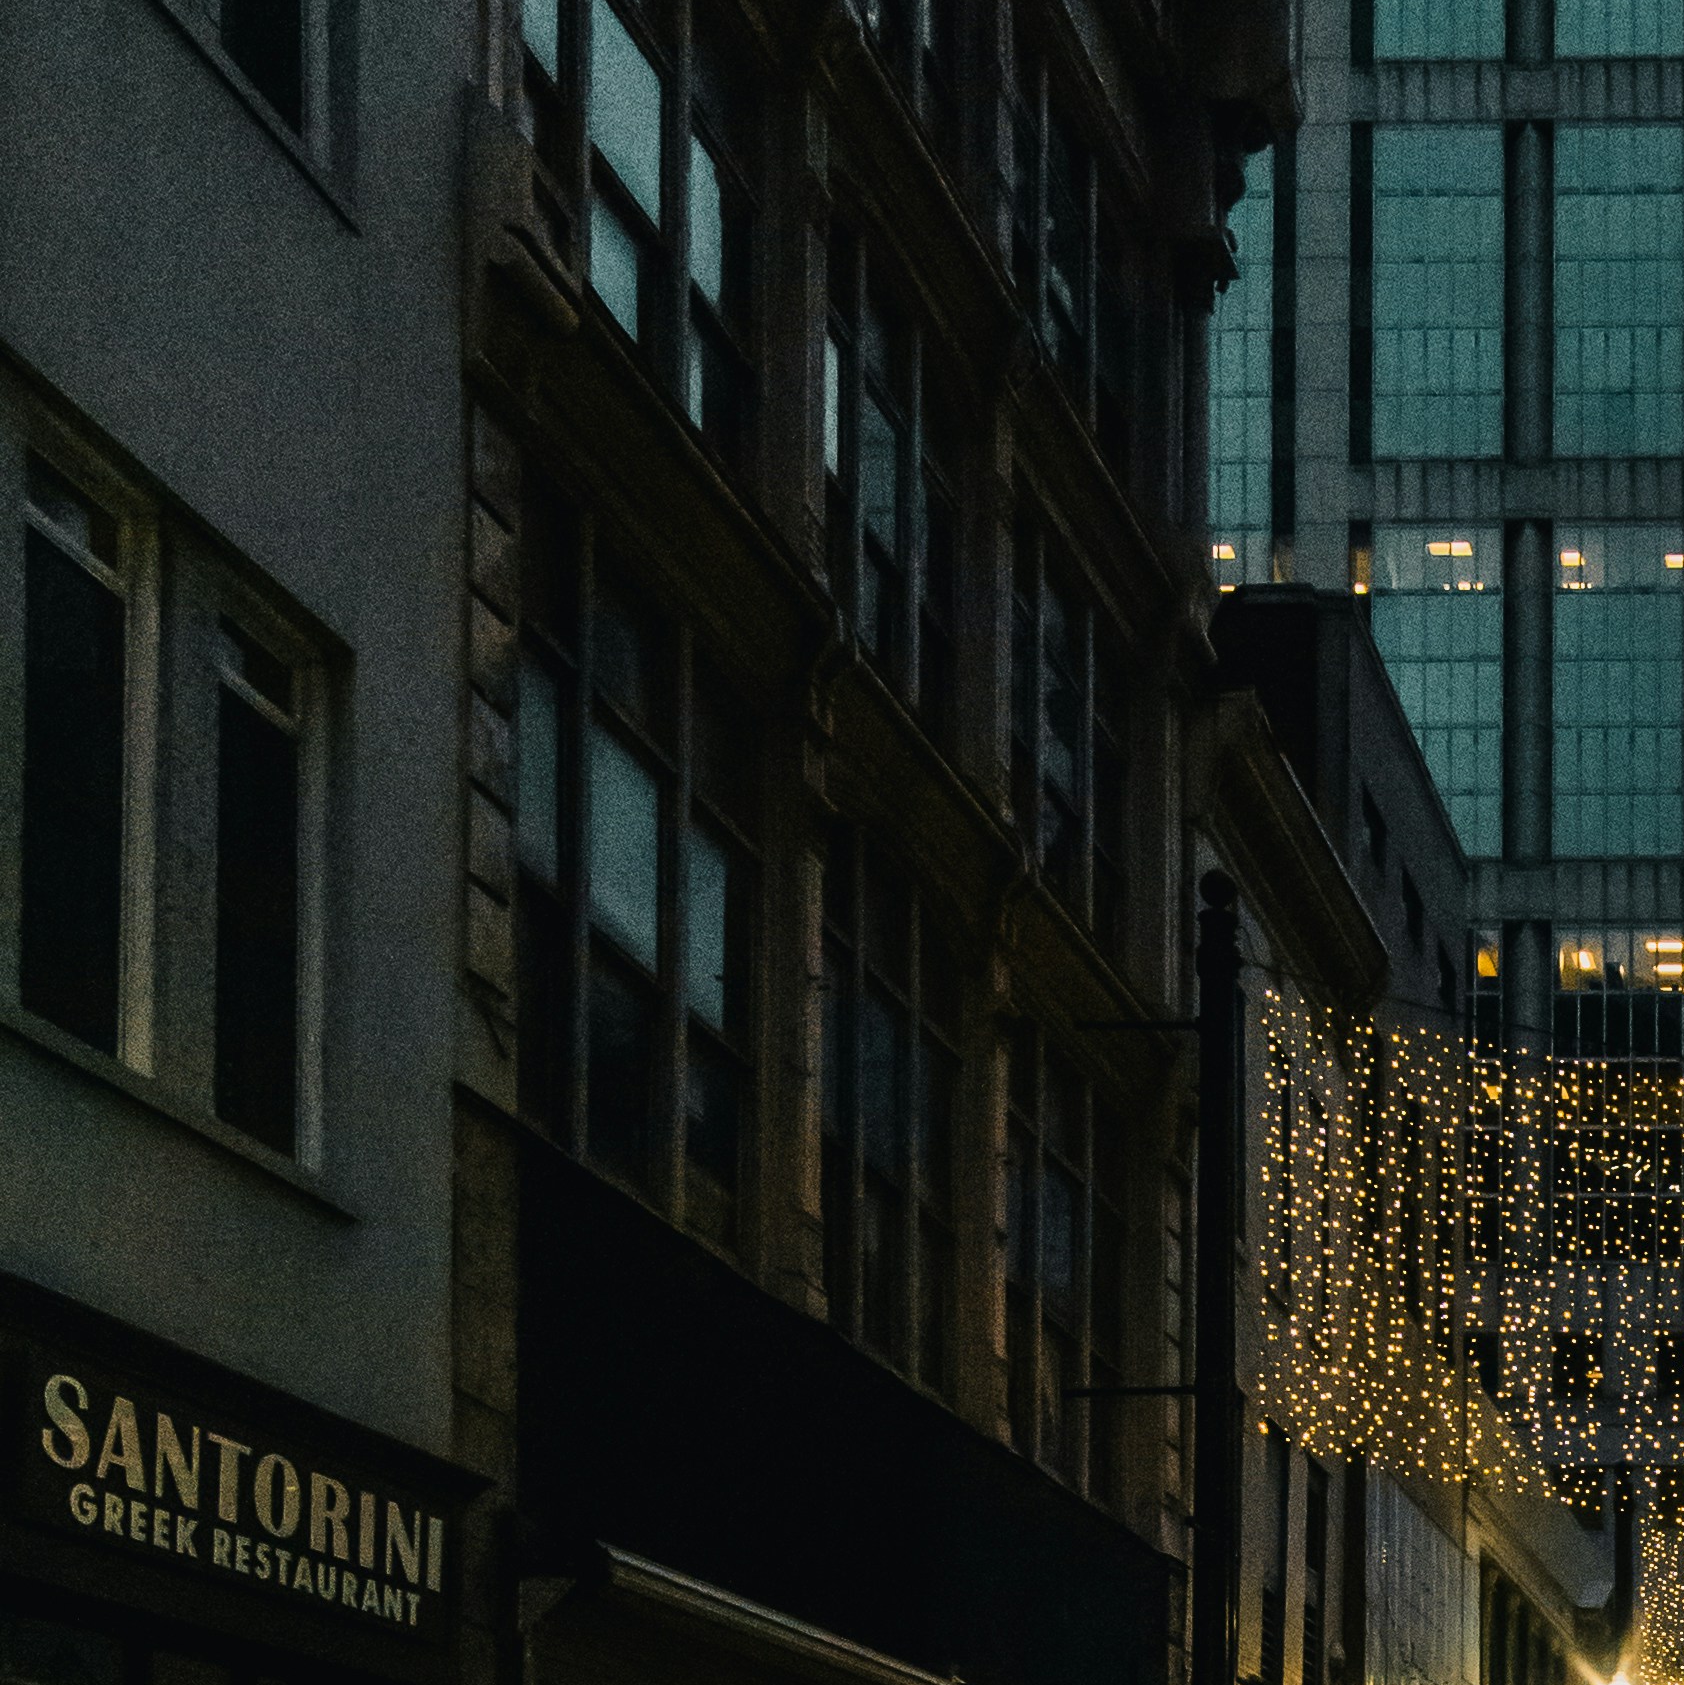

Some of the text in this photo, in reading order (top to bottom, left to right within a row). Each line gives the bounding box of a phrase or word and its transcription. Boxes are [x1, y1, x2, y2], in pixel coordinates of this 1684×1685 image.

[41, 1373, 445, 1595] SANTORINI
[68, 1481, 423, 1628] GREEK RESTAURANT
